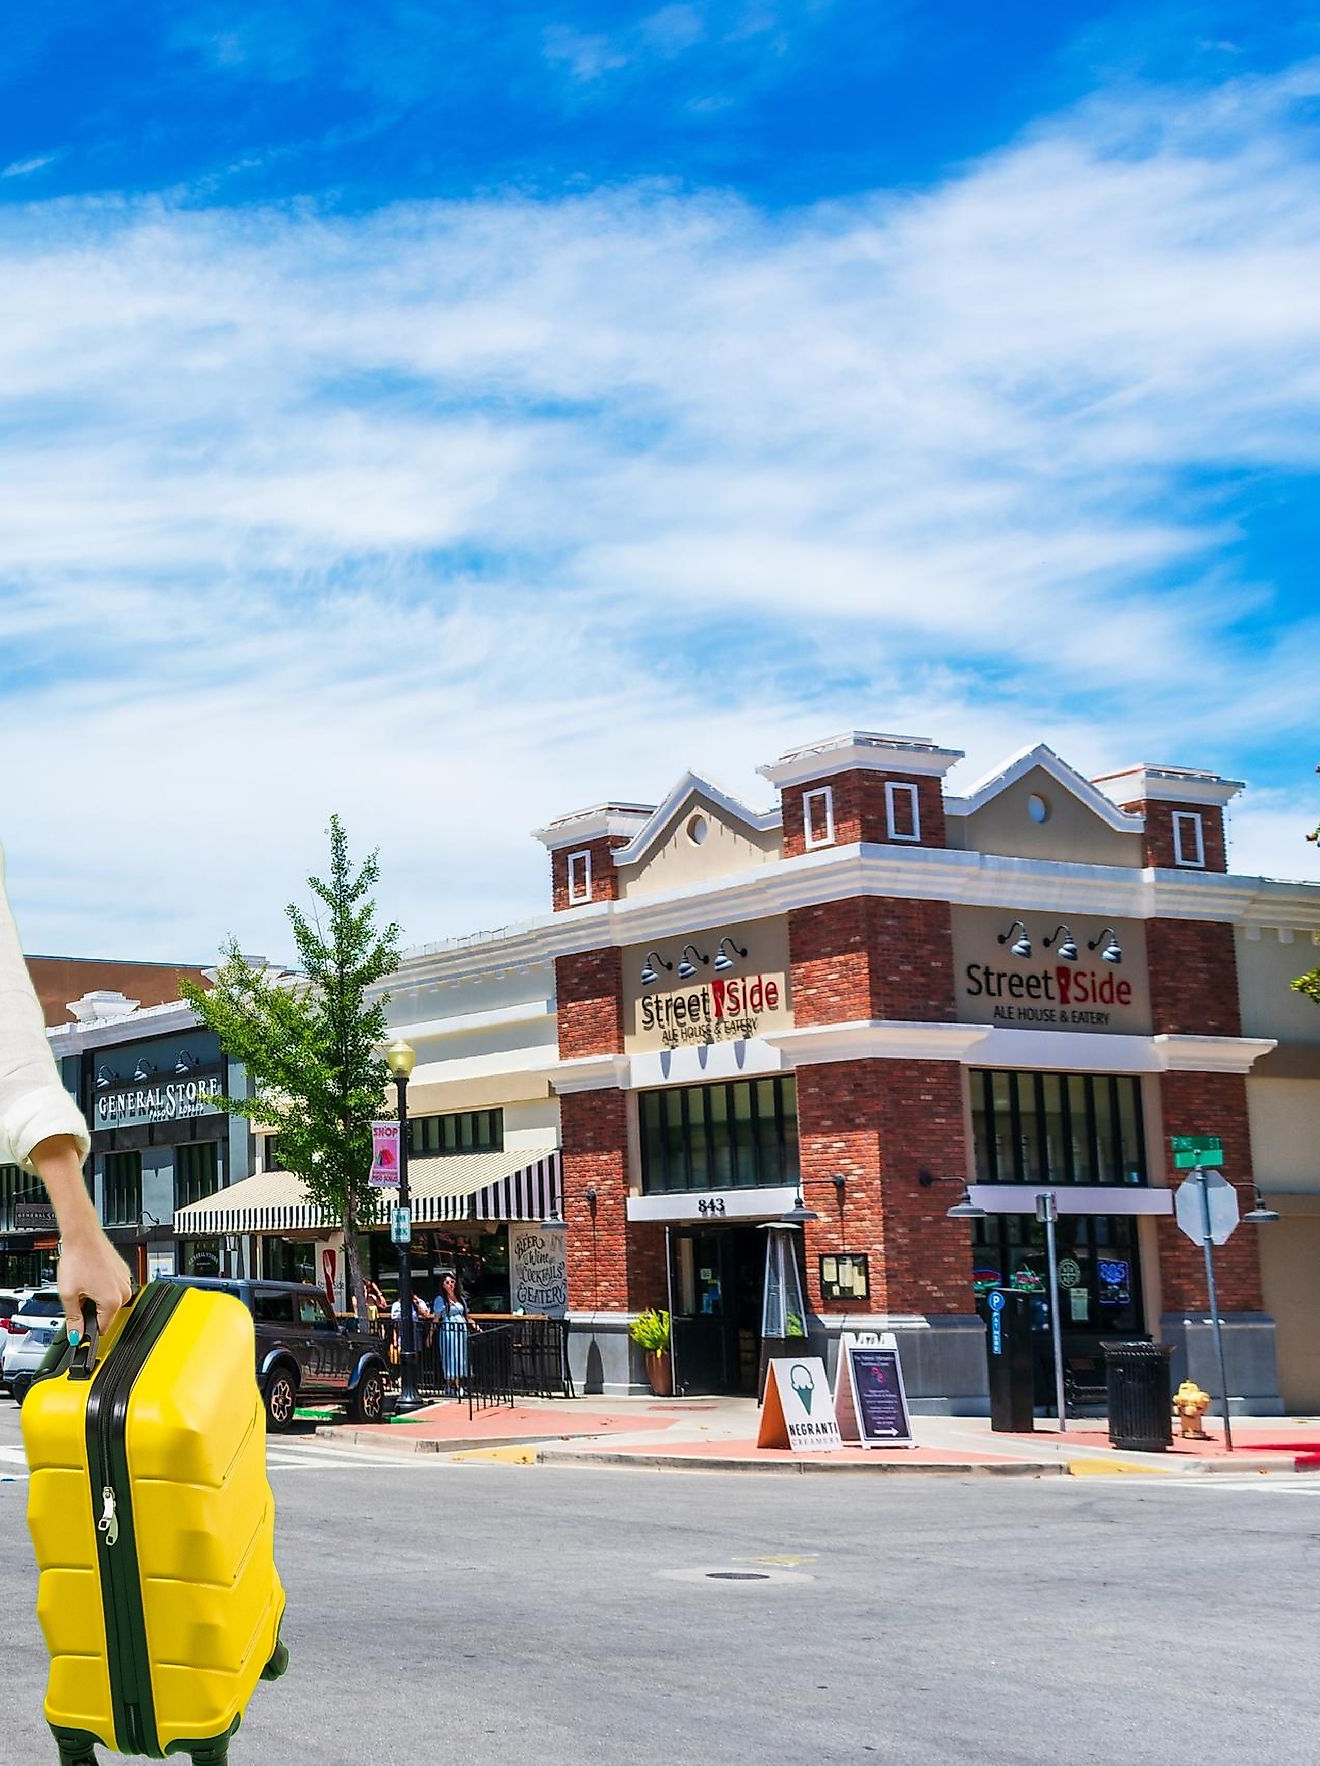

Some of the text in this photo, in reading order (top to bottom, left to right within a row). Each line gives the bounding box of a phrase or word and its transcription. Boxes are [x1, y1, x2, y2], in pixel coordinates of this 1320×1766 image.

[967, 964, 1132, 1005] Street Side
[641, 975, 778, 1025] Street Side
[994, 1006, 1111, 1025] ALE HOUSE & EATERY
[662, 1028, 679, 1042] ALE
[680, 1024, 710, 1040] HOUSE
[723, 1017, 758, 1035] EATERY
[98, 1078, 219, 1117] GENERAL STORE
[373, 1127, 399, 1138] SHOP
[698, 1197, 726, 1212] 843
[515, 1233, 545, 1260] BEER
[788, 1421, 839, 1437] NEGRANTI
